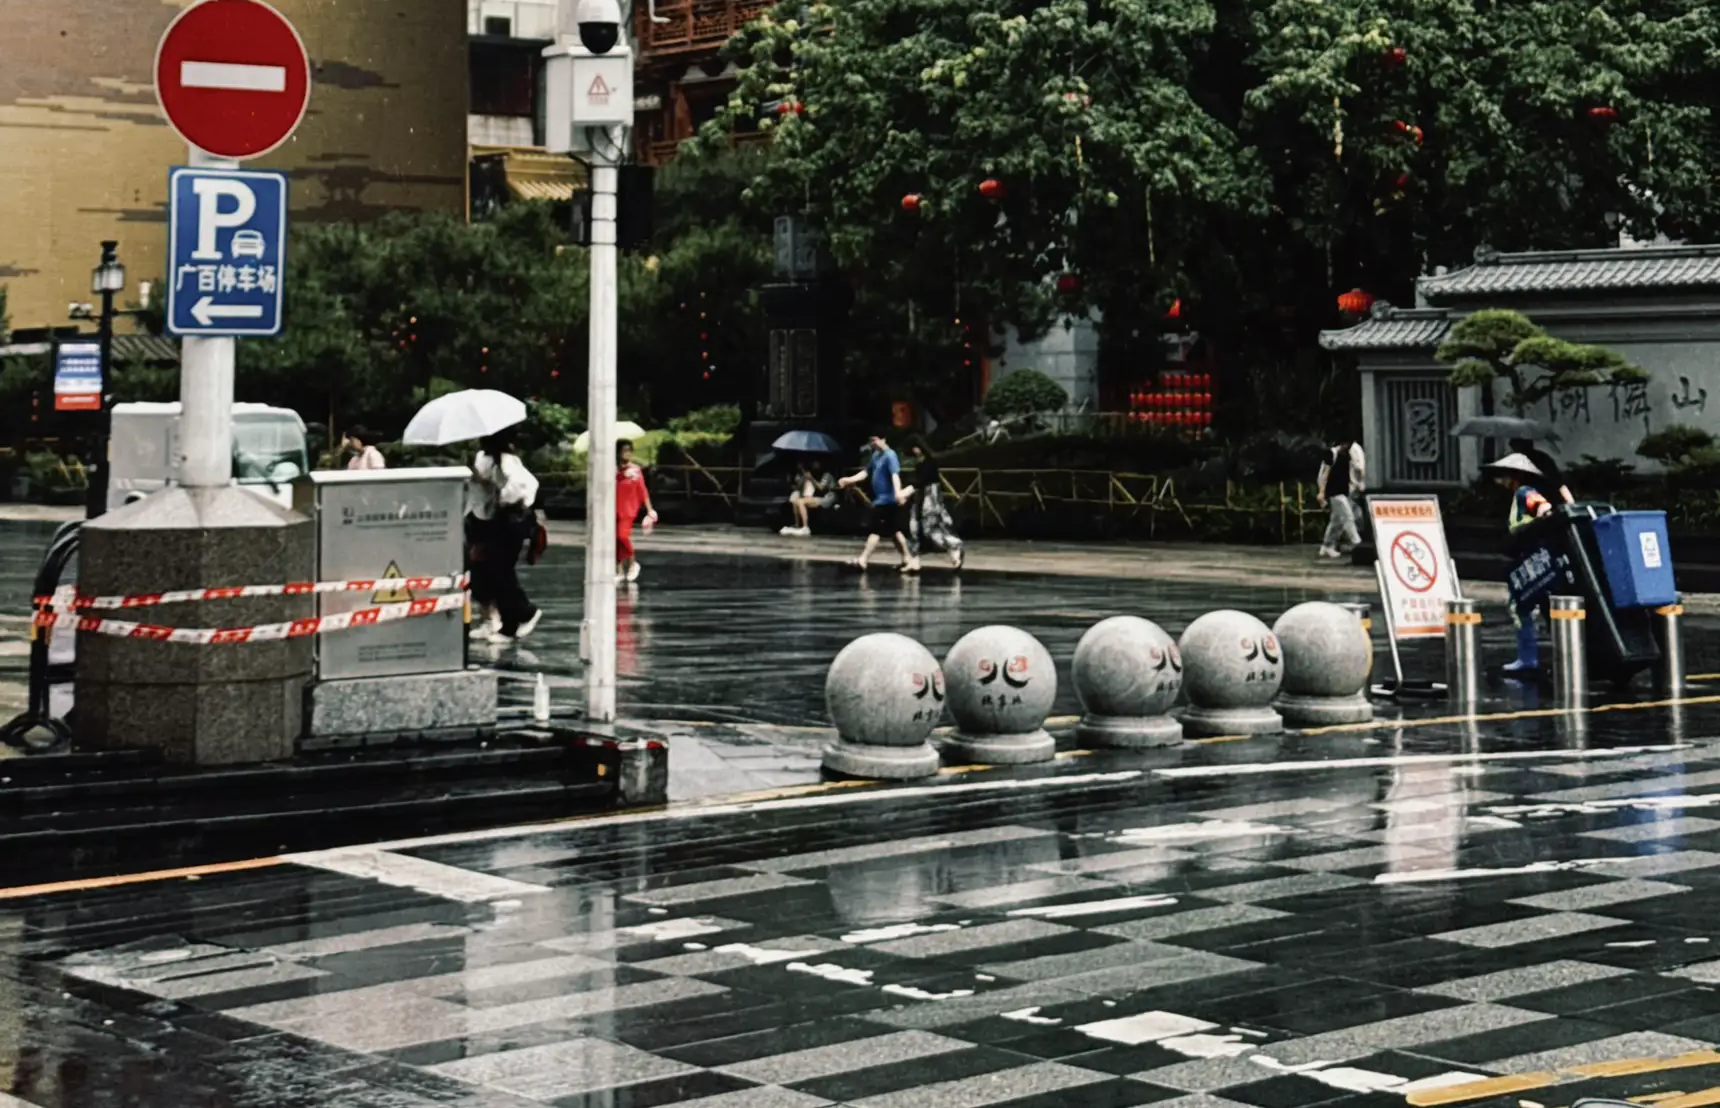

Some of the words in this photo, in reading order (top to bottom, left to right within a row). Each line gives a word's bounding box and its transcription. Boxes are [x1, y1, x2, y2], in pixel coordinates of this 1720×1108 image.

[191, 177, 257, 260] P
[176, 263, 277, 294] 广百停车场
